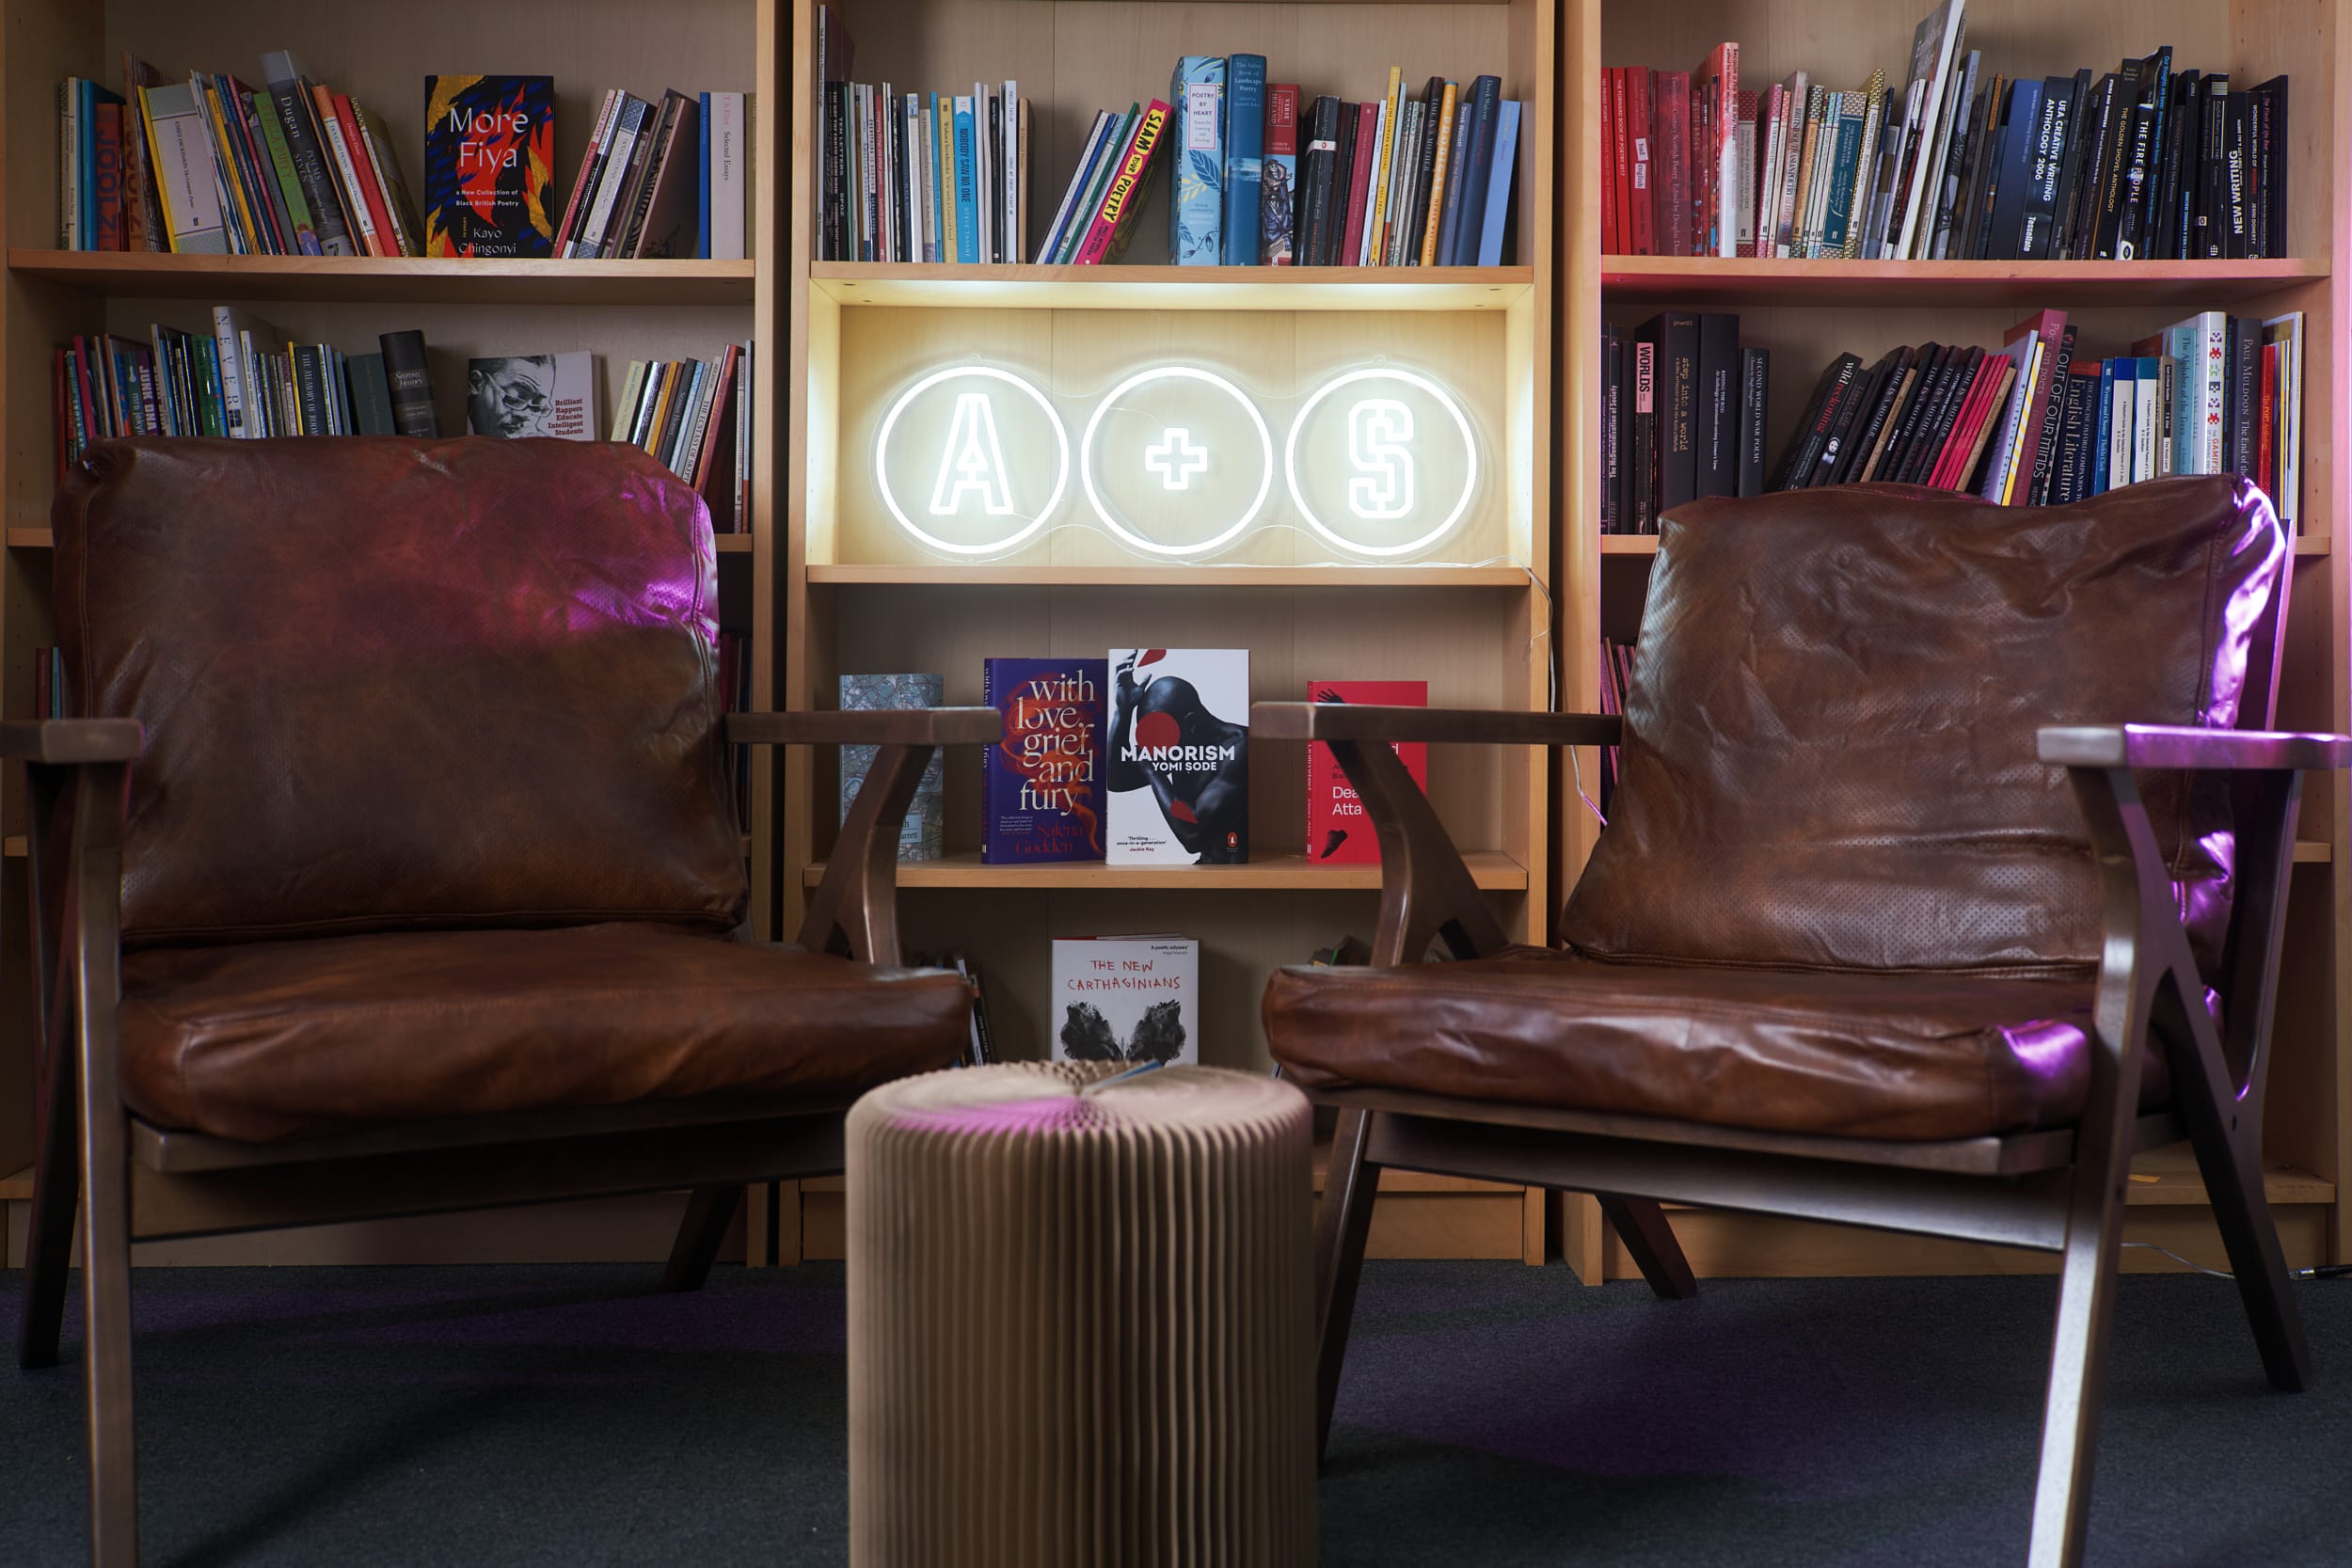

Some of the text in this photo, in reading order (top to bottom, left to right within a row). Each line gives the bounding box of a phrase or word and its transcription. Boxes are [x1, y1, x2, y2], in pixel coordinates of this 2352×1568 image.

[281, 96, 299, 138] Dugan
[450, 107, 528, 134] More
[1430, 97, 1438, 116] TIME
[259, 102, 294, 180] STELLA DUFFY
[345, 122, 357, 141] Douglas
[959, 128, 969, 156] NOBODY
[2034, 98, 2056, 181] ANTHOLOGY 2006
[2116, 119, 2126, 146] GOLDEN
[460, 141, 517, 174] Fiya
[1422, 137, 1433, 171] MOTHER
[1786, 107, 1802, 195] BRITISH SOUTH ASIAN POETRY
[2042, 99, 2066, 201] UEA CREATIVE WRITING
[2112, 147, 2122, 172] SHOVEL
[2128, 119, 2149, 203] THE FIRE PEOPLE
[294, 153, 308, 182] SEVEN
[307, 150, 321, 181] POEMS
[960, 158, 969, 174] SAW
[1103, 112, 1164, 222] SLAM YOUR POETRY
[97, 129, 117, 232] JOOLZ
[961, 176, 969, 185] NO
[961, 188, 970, 201] ONE
[2106, 173, 2118, 212] ANTHOLOGY
[2228, 150, 2243, 233] NEW WRITING
[473, 228, 501, 240] Kayo
[2023, 215, 2036, 251] Tessellate
[458, 243, 516, 256] Chingonyi
[2034, 322, 2059, 394] Poets on poets
[2241, 338, 2252, 361] PAUL
[1638, 346, 1651, 391] WORLDS
[1680, 357, 1689, 378] step
[1893, 366, 1904, 386] TIME
[1925, 365, 1937, 386] TIME
[1941, 366, 1953, 386] TIME
[1963, 366, 1975, 386] TIME
[2054, 352, 2069, 380] OUT
[2179, 353, 2189, 388] Alphabet
[138, 364, 156, 430] JUNK DNA
[1609, 385, 1619, 405] Society
[1887, 387, 1895, 395] IS
[1921, 386, 1929, 394] IS
[1936, 388, 1944, 396] IS
[2048, 383, 2062, 403] OF
[2181, 389, 2188, 398] of
[2240, 365, 2253, 414] MULDOON
[1868, 404, 1886, 437] MOTHER
[1902, 403, 1921, 437] MOTHER
[1918, 404, 1937, 438] MOTHER
[1942, 404, 1959, 438] MOTHER
[2042, 404, 2058, 434] OUR
[2083, 394, 2091, 421] CONCISE
[1679, 422, 1688, 451] world
[2058, 378, 2084, 500] English Literature
[2080, 424, 2089, 451] OXFORD
[2179, 416, 2187, 436] Trees
[2240, 420, 2249, 436] The
[1610, 415, 1619, 467] McDonaldization
[2240, 437, 2249, 453] End
[930, 393, 1014, 515] A
[1348, 399, 1414, 518] S
[2076, 451, 2086, 492] COMPANION
[1029, 670, 1096, 702] with
[1023, 722, 1095, 767] grief
[1120, 745, 1235, 762] MANORISM
[1039, 750, 1093, 783] and
[1152, 762, 1182, 771] YOMI
[1019, 779, 1077, 816] fury
[1332, 802, 1361, 816] Atta
[1091, 959, 1153, 973] THE NEW
[1068, 976, 1181, 990] CARTHAGINIANS
